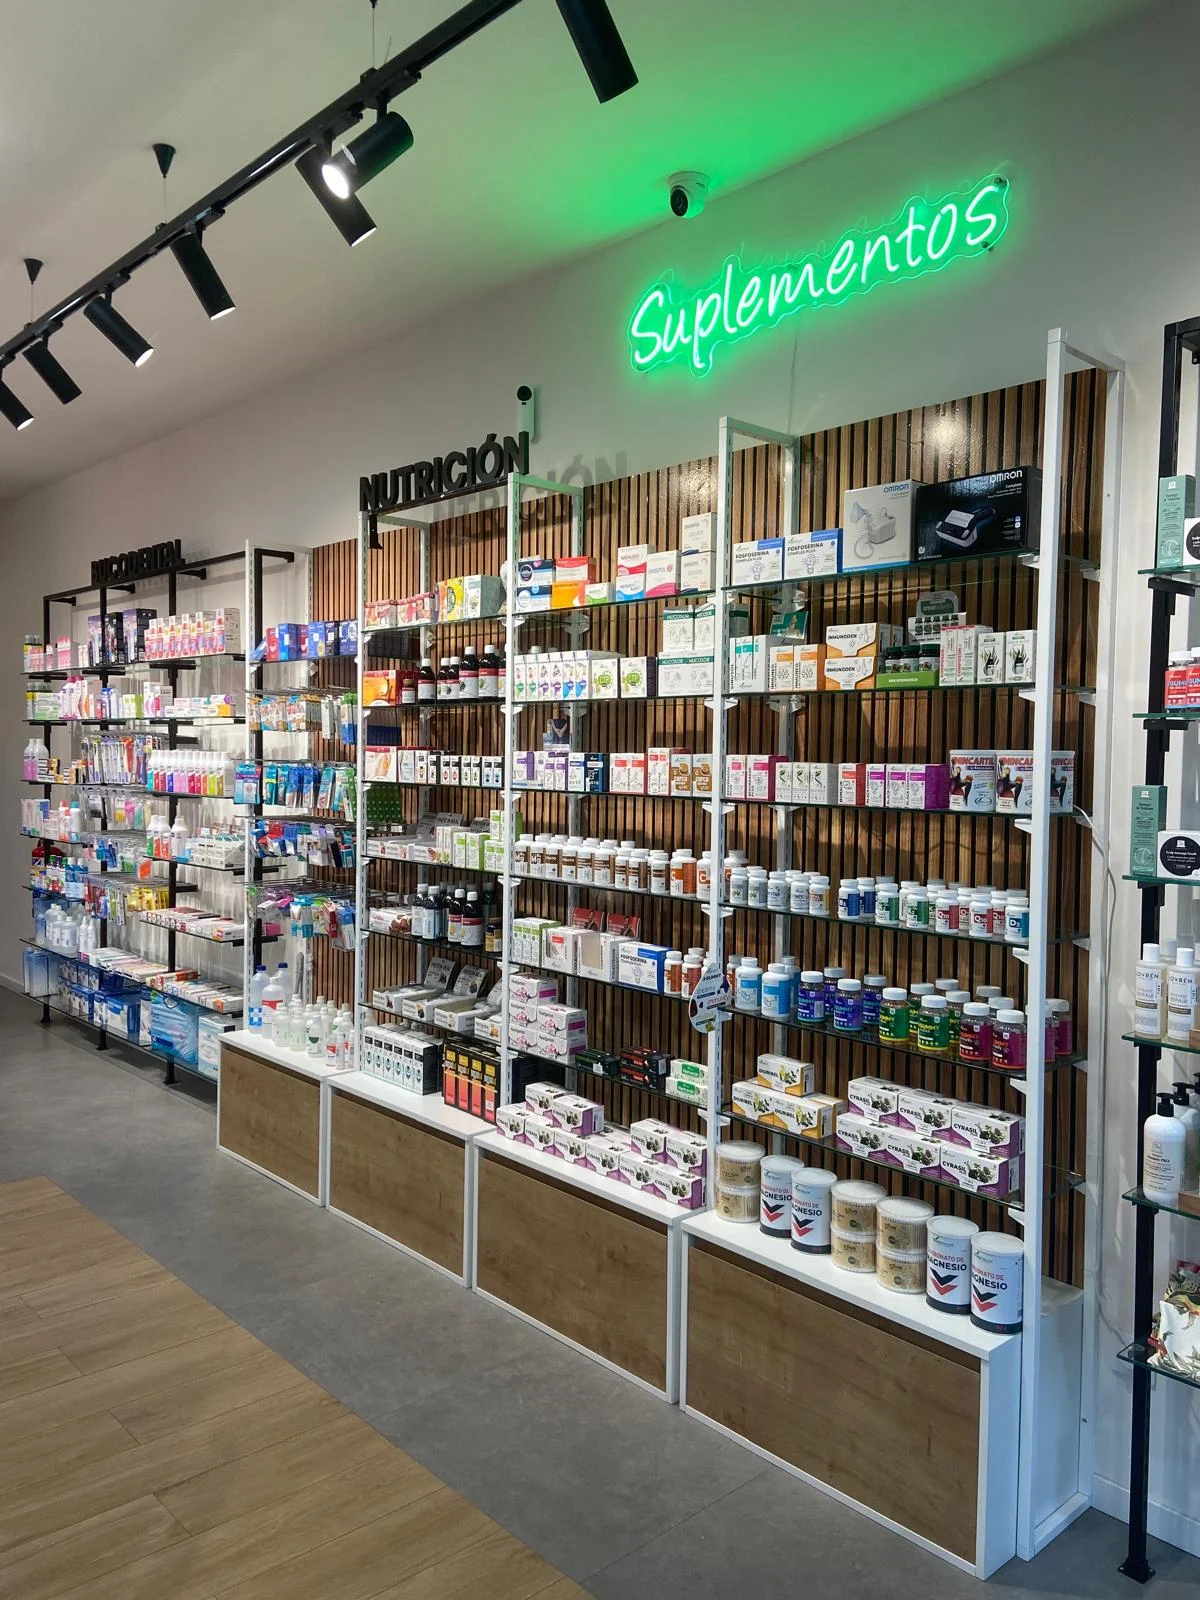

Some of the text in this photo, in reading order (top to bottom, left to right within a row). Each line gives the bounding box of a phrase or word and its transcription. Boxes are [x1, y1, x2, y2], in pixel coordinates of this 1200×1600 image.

[631, 185, 999, 368] Suplementos
[359, 431, 529, 511] NUTRICIÓN
[989, 470, 1023, 484] OMRON
[883, 483, 909, 494] OMRON
[787, 542, 824, 552] FOSFOSERINA
[735, 550, 769, 559] FOSFOSERINA
[531, 855, 541, 863] Mg
[700, 873, 706, 882] C
[937, 911, 949, 919] Q10
[849, 1094, 871, 1104] CYRASIL
[900, 1107, 922, 1117] CYRASIL
[953, 1123, 977, 1134] CYRASIL
[837, 1129, 859, 1139] CYRASIL
[887, 1144, 909, 1154] CYRASIL
[942, 1160, 966, 1171] CYRASIL
[761, 1189, 792, 1201] AGNESIO
[792, 1204, 822, 1216] AGNESIO
[971, 1272, 1007, 1290] AGNESIO
